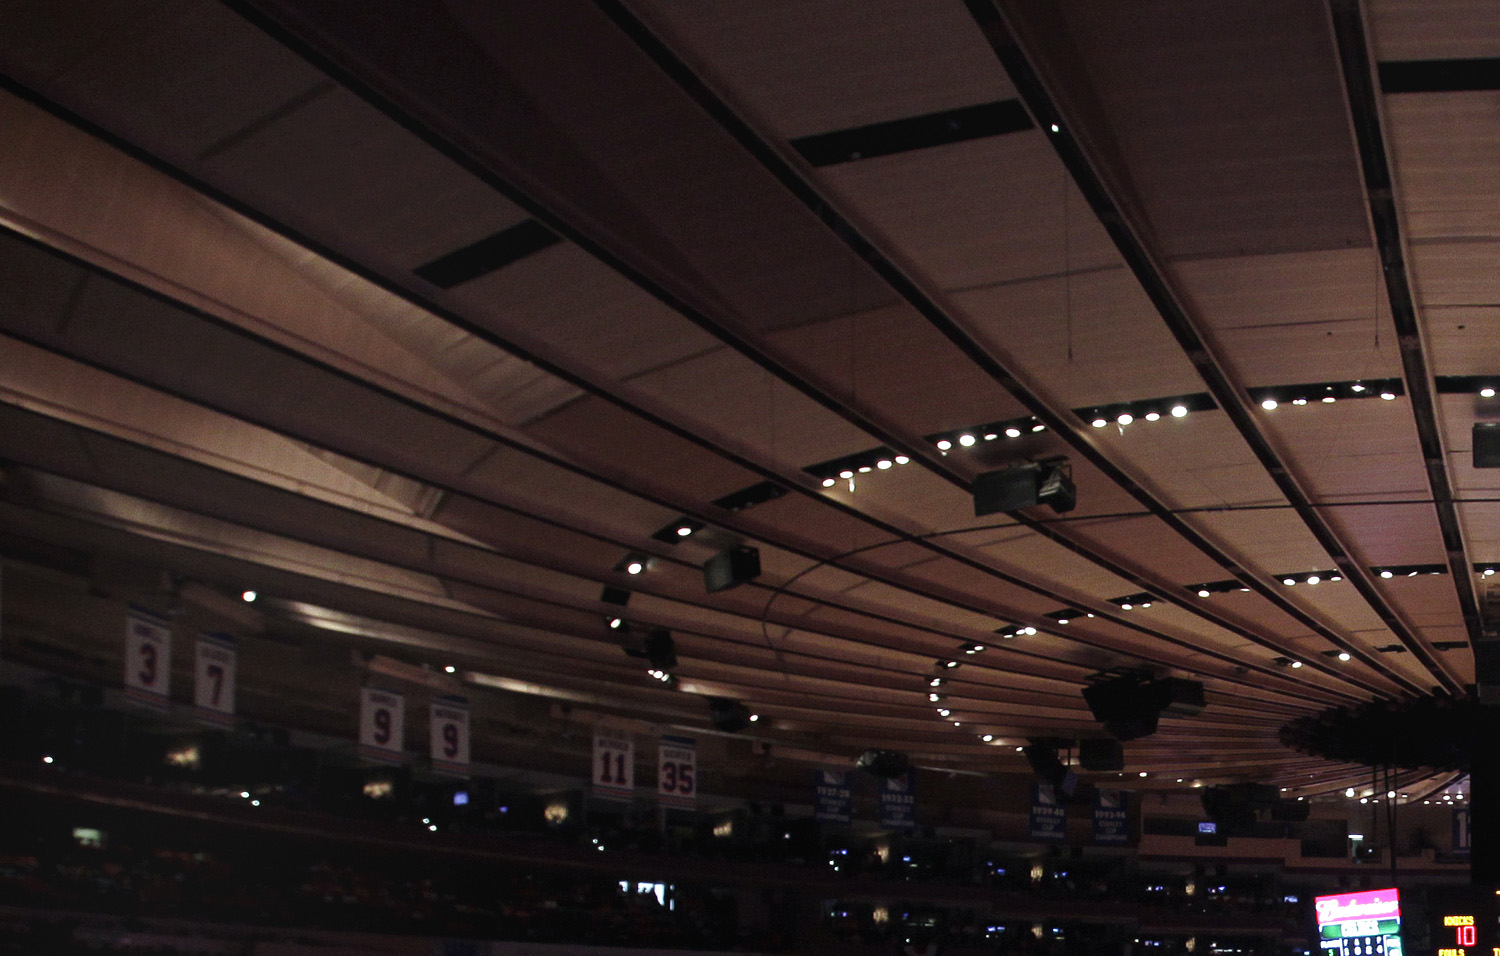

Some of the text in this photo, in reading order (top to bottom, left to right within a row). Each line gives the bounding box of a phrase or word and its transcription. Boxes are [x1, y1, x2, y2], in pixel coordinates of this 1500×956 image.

[139, 644, 157, 685] 3
[208, 664, 223, 705] 7
[374, 709, 390, 744] 9
[443, 724, 457, 758] 9
[601, 752, 626, 785] 11
[662, 762, 693, 794] 35
[1341, 920, 1379, 937] CELTICS
[1444, 916, 1475, 926] KNICKS
[1456, 925, 1477, 946] 10
[1328, 949, 1334, 956] 5
